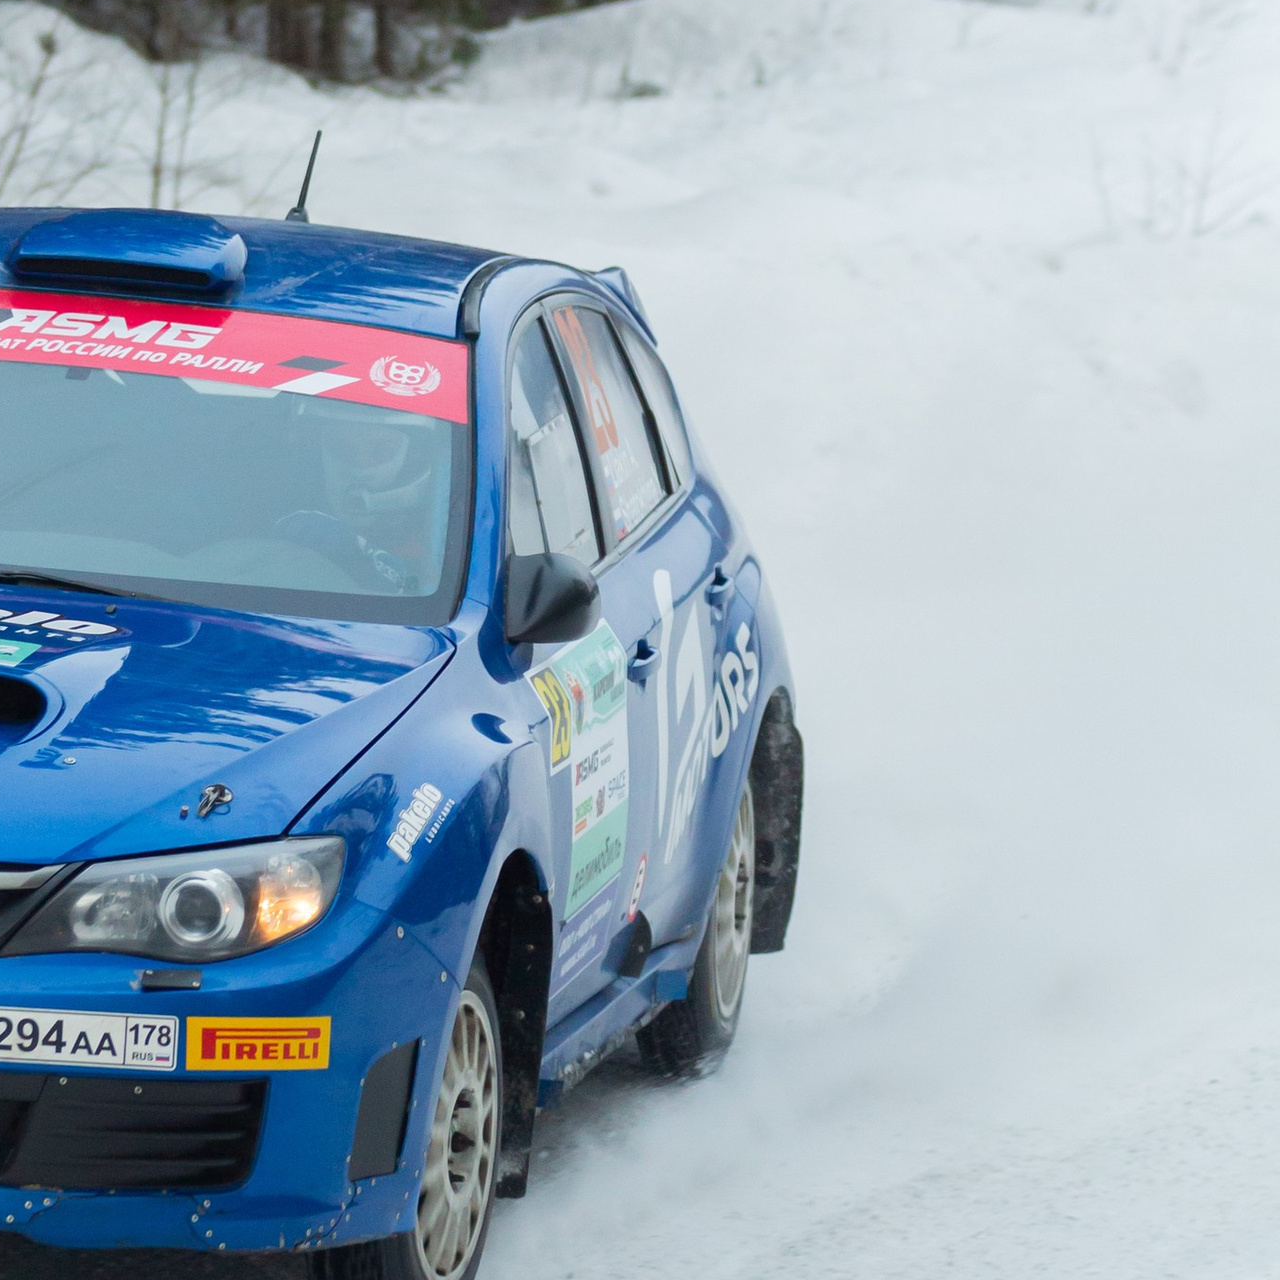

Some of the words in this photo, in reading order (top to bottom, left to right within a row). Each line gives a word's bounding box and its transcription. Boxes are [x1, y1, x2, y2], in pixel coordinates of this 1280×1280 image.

[25, 337, 133, 360] РОССИИ
[168, 352, 265, 375] РАЛЛИ
[553, 306, 619, 455] 23
[533, 671, 571, 763] 23
[386, 782, 443, 863] pakelo
[128, 1023, 172, 1047] 178
[201, 1028, 321, 1061] PIRELLI
[131, 1052, 154, 1061] RUS
